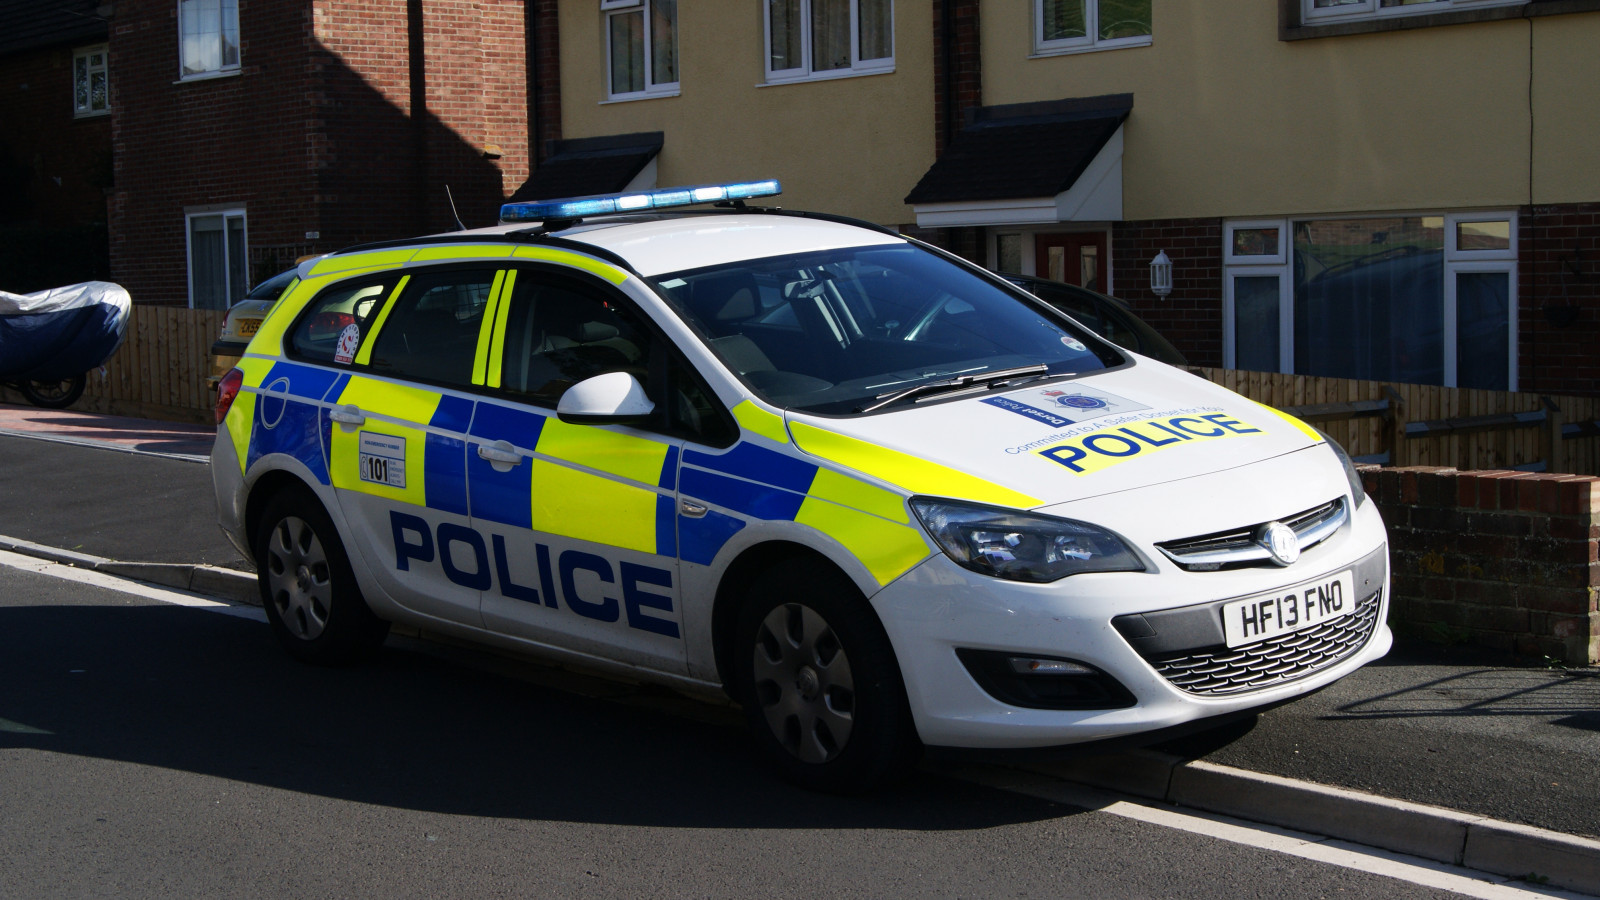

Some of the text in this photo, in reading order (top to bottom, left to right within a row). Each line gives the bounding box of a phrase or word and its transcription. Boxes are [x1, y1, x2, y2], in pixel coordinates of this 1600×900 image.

[993, 398, 1066, 425] Dorset Police
[1004, 429, 1080, 455] Committed
[1076, 425, 1094, 434] to
[1092, 421, 1107, 430] A
[1103, 415, 1140, 425] Safer
[1038, 413, 1263, 473] POLICE
[369, 457, 388, 482] 101
[389, 510, 680, 639] POLICE
[1241, 580, 1343, 638] HF13 FNO
